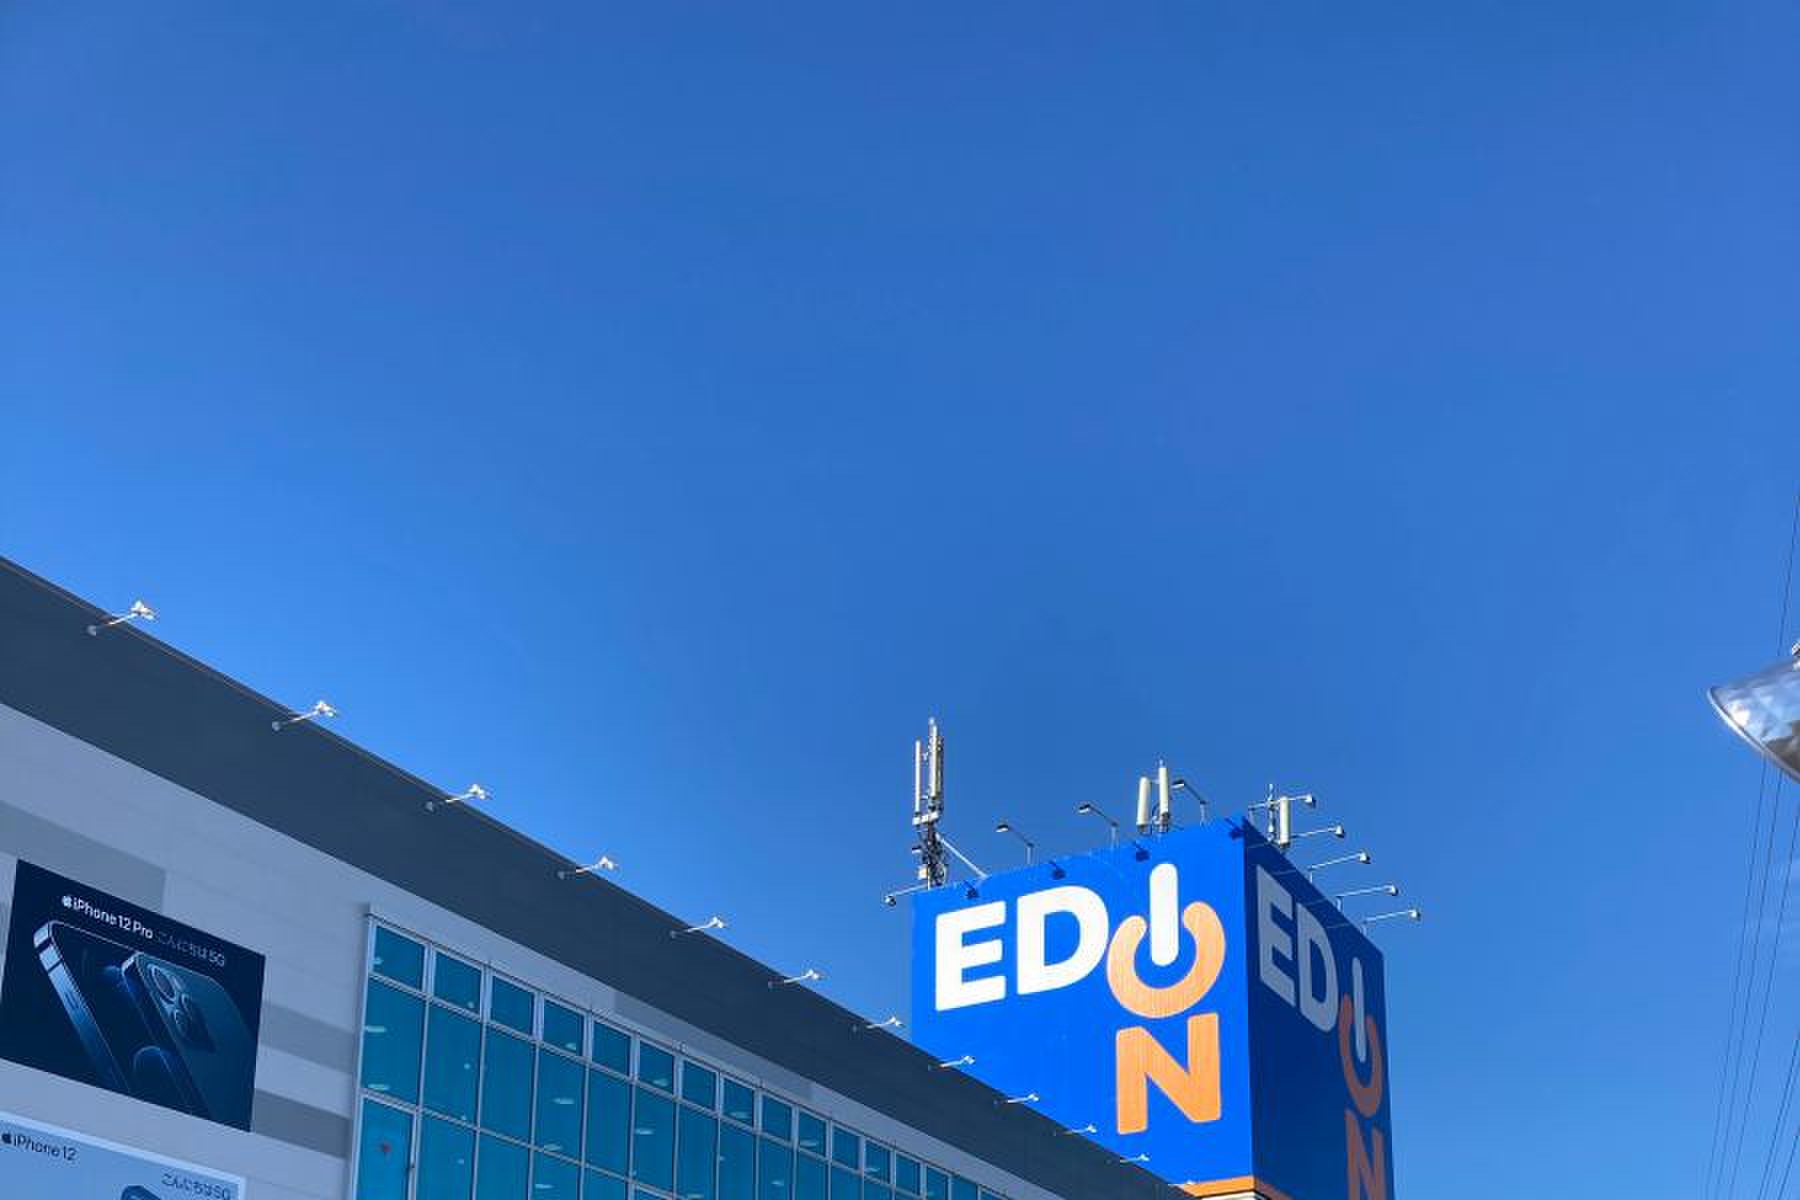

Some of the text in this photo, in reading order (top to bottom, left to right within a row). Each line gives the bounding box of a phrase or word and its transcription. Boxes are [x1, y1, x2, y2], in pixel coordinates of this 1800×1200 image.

[73, 897, 153, 939] iPhone 12 Pro
[936, 863, 1226, 1135] EDION
[13, 1135, 78, 1161] iPhone 12
